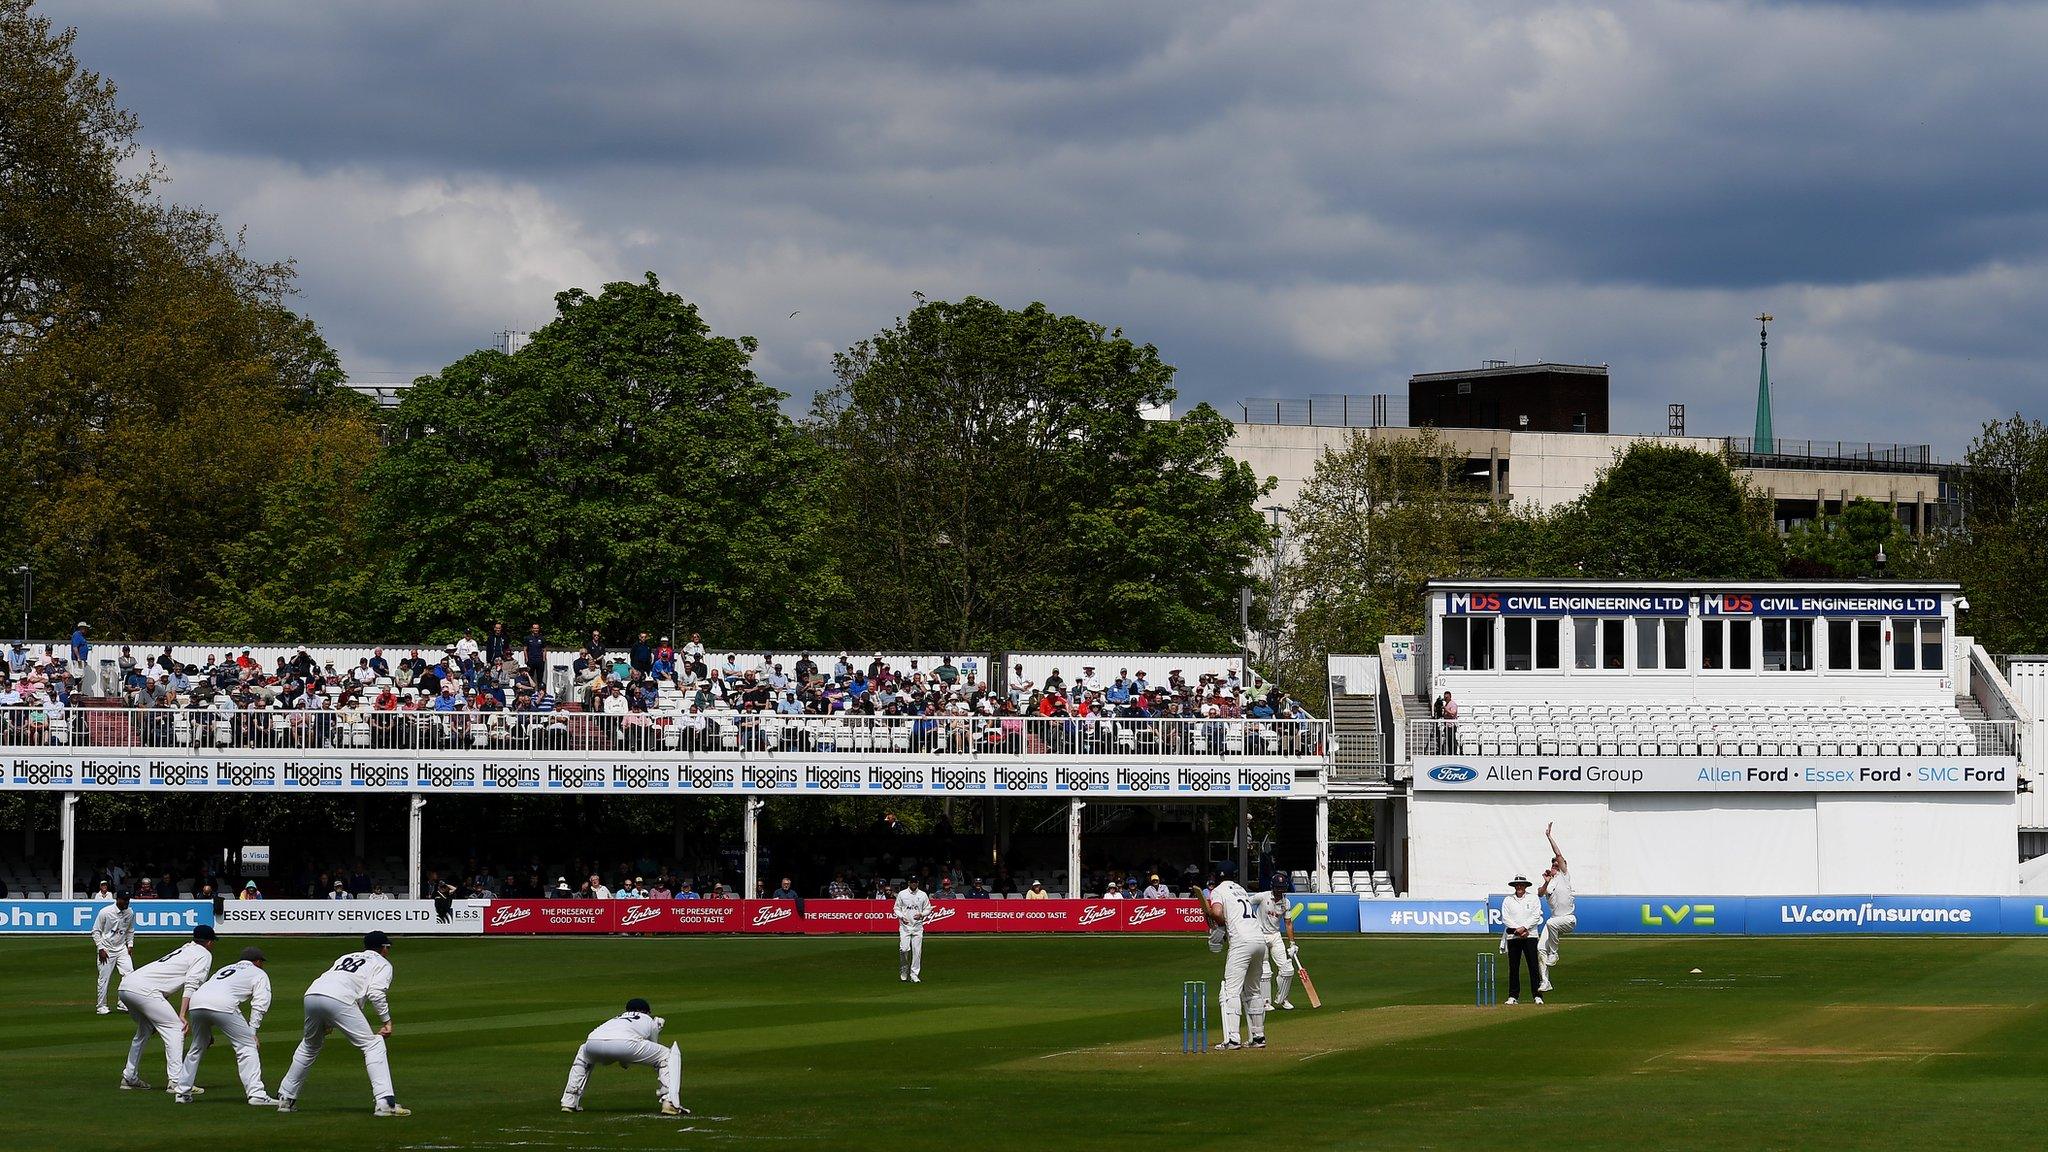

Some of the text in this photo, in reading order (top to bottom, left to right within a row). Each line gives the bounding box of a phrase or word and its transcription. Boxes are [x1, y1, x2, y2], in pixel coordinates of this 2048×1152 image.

[1451, 593, 1684, 613] MDS CIVIL ENGINEERING LTD
[1704, 594, 1936, 614] MDS CIVIL ENGINEERING LTD
[14, 760, 72, 784] Higgins
[82, 761, 140, 785] Higgins
[150, 762, 208, 785] Higgins
[217, 762, 275, 786] Higgins
[285, 763, 342, 786] Higgins
[351, 763, 408, 786] Higgins
[418, 763, 474, 787] Higgins
[483, 764, 539, 787] Higgins
[549, 765, 604, 788] Higgins
[614, 765, 669, 788] Higgins
[678, 765, 733, 788] Higgins
[743, 766, 797, 788] Higgins
[806, 766, 860, 789] Higgins
[869, 767, 923, 789] Higgins
[932, 767, 986, 790] Higgins
[994, 768, 1047, 790] Higgins
[1056, 768, 1109, 790] Higgins
[1117, 769, 1170, 791] Higgins
[1179, 769, 1230, 791] Higgins
[1239, 769, 1290, 791] Higgins
[1437, 767, 1469, 782] Ford
[1486, 765, 1643, 784] Allen Ford Group
[1697, 767, 2005, 782] Allen Ford Essex Ford SMC Ford
[135, 907, 199, 927] unt
[223, 910, 430, 921] ESSEX SECURITY SERVICES LTD
[455, 910, 480, 919] E.S.S.
[490, 905, 531, 927] Tiptree
[541, 908, 605, 916] THE PRESERVE OF
[550, 916, 596, 924] GOOD TASTE
[621, 906, 662, 926] Tiptree
[679, 916, 702, 924] GOOD
[752, 906, 792, 926] Tiptree
[804, 912, 898, 920] THE PRESERVE OF GOOD TAS
[1078, 906, 1116, 926] Tiptree
[1128, 906, 1167, 926] Tiptree
[1175, 907, 1189, 915] THE
[1184, 915, 1205, 923] GOOD
[1781, 903, 1972, 926] LV.com/insurance
